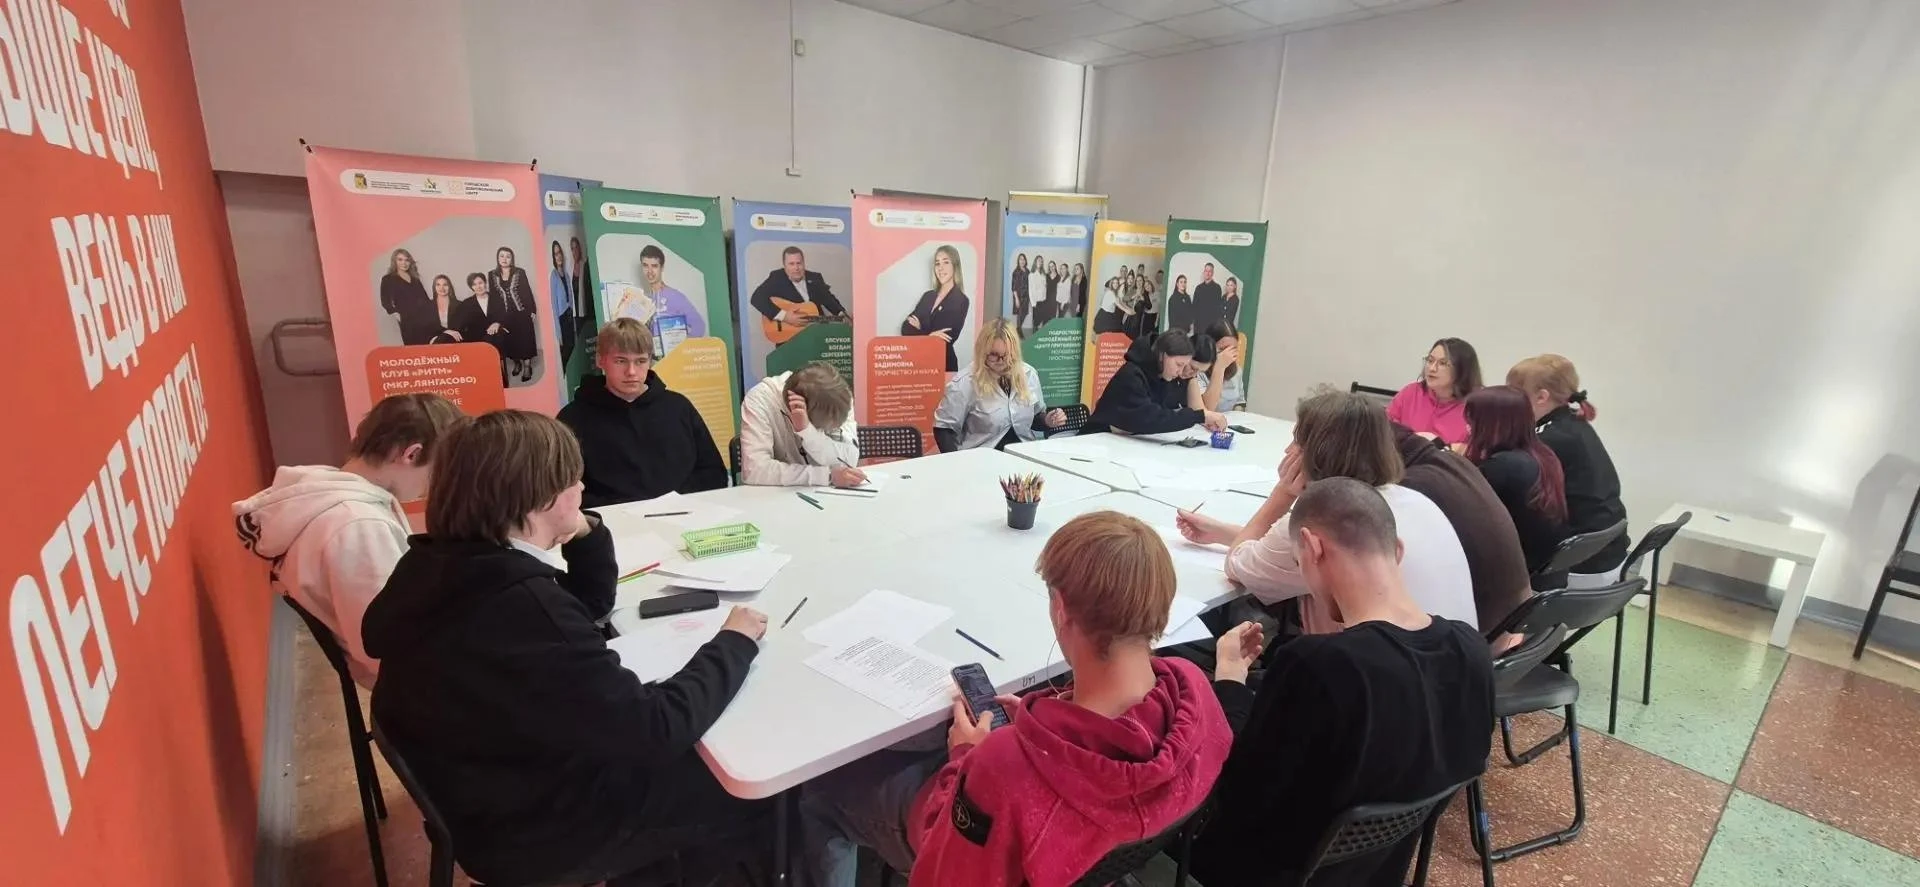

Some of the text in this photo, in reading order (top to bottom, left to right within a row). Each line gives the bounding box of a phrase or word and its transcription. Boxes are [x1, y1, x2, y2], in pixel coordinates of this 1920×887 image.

[50, 212, 145, 391] ВЕДЬ
[126, 214, 160, 335] В
[380, 354, 460, 367] МОЛОДЁЖНЫЙ
[381, 367, 452, 378] КЛУБ «РИТМ»
[9, 438, 152, 836] ЛЕГЧЕ
